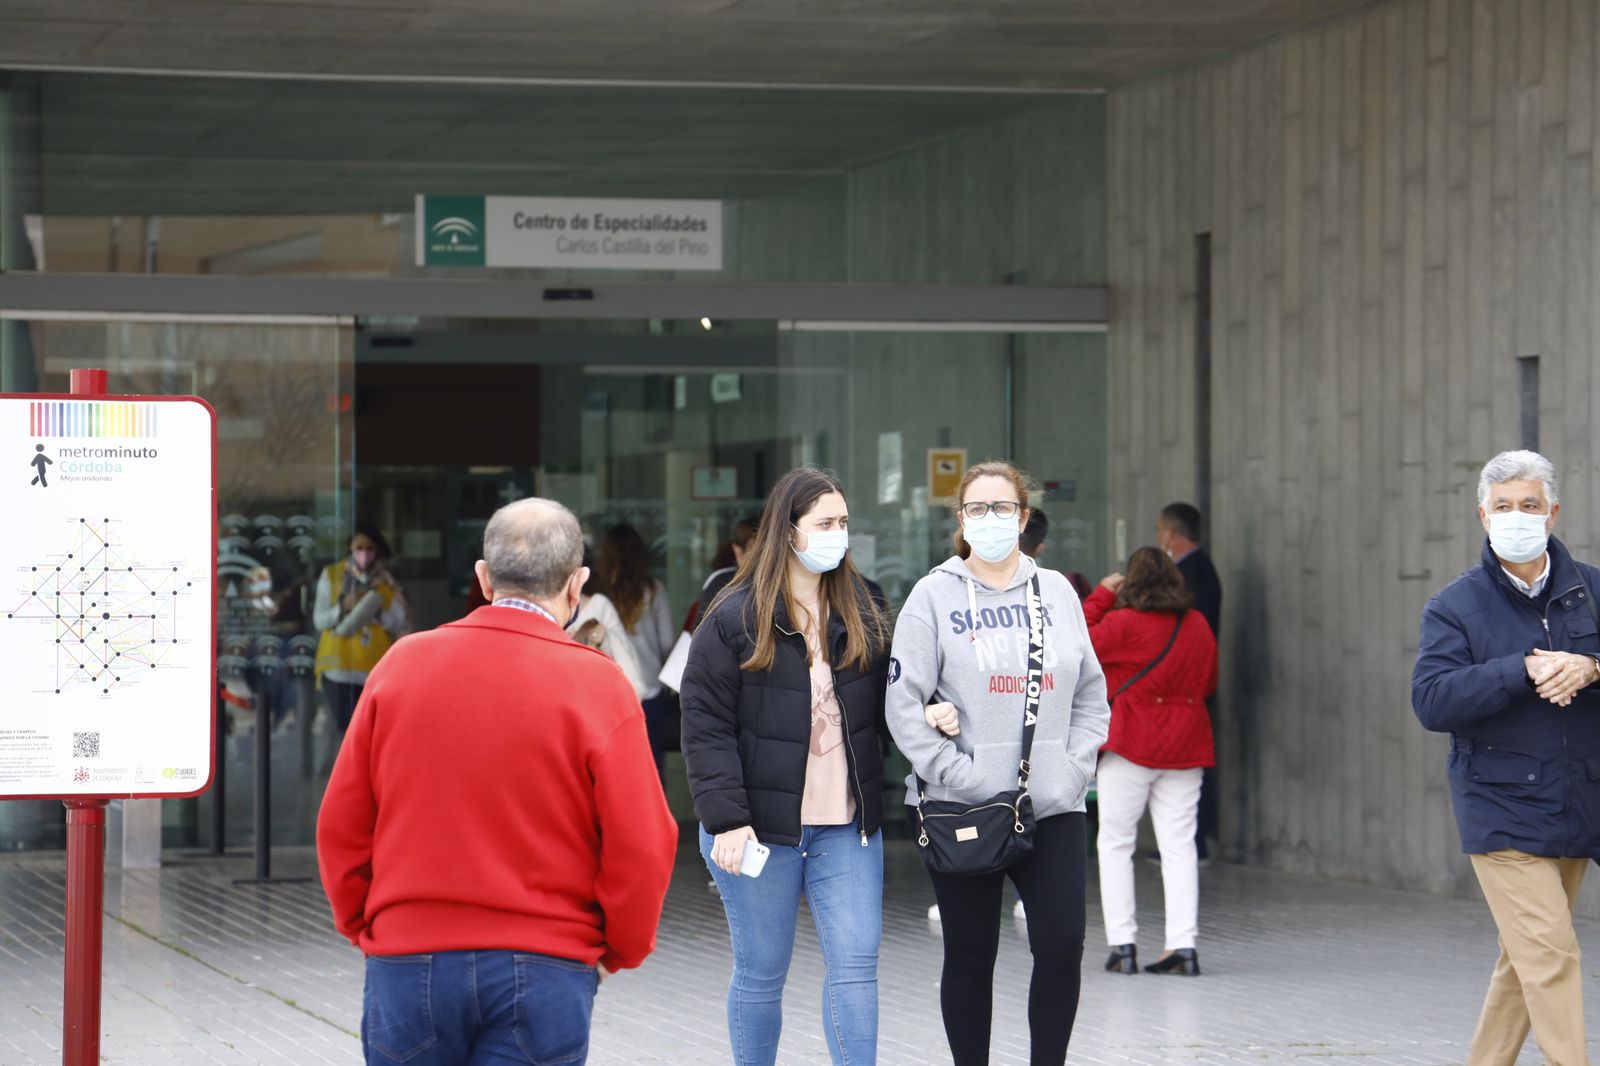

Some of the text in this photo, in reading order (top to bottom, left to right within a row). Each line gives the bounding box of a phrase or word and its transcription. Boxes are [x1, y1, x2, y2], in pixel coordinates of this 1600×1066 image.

[513, 211, 708, 234] Centro de Especialidades
[556, 235, 709, 257] Carlos Castilla del Pino
[59, 446, 158, 459] metrominuto
[59, 460, 122, 473] Córdoba
[59, 475, 80, 483] Mejor
[1024, 669, 1042, 727] LOLA
